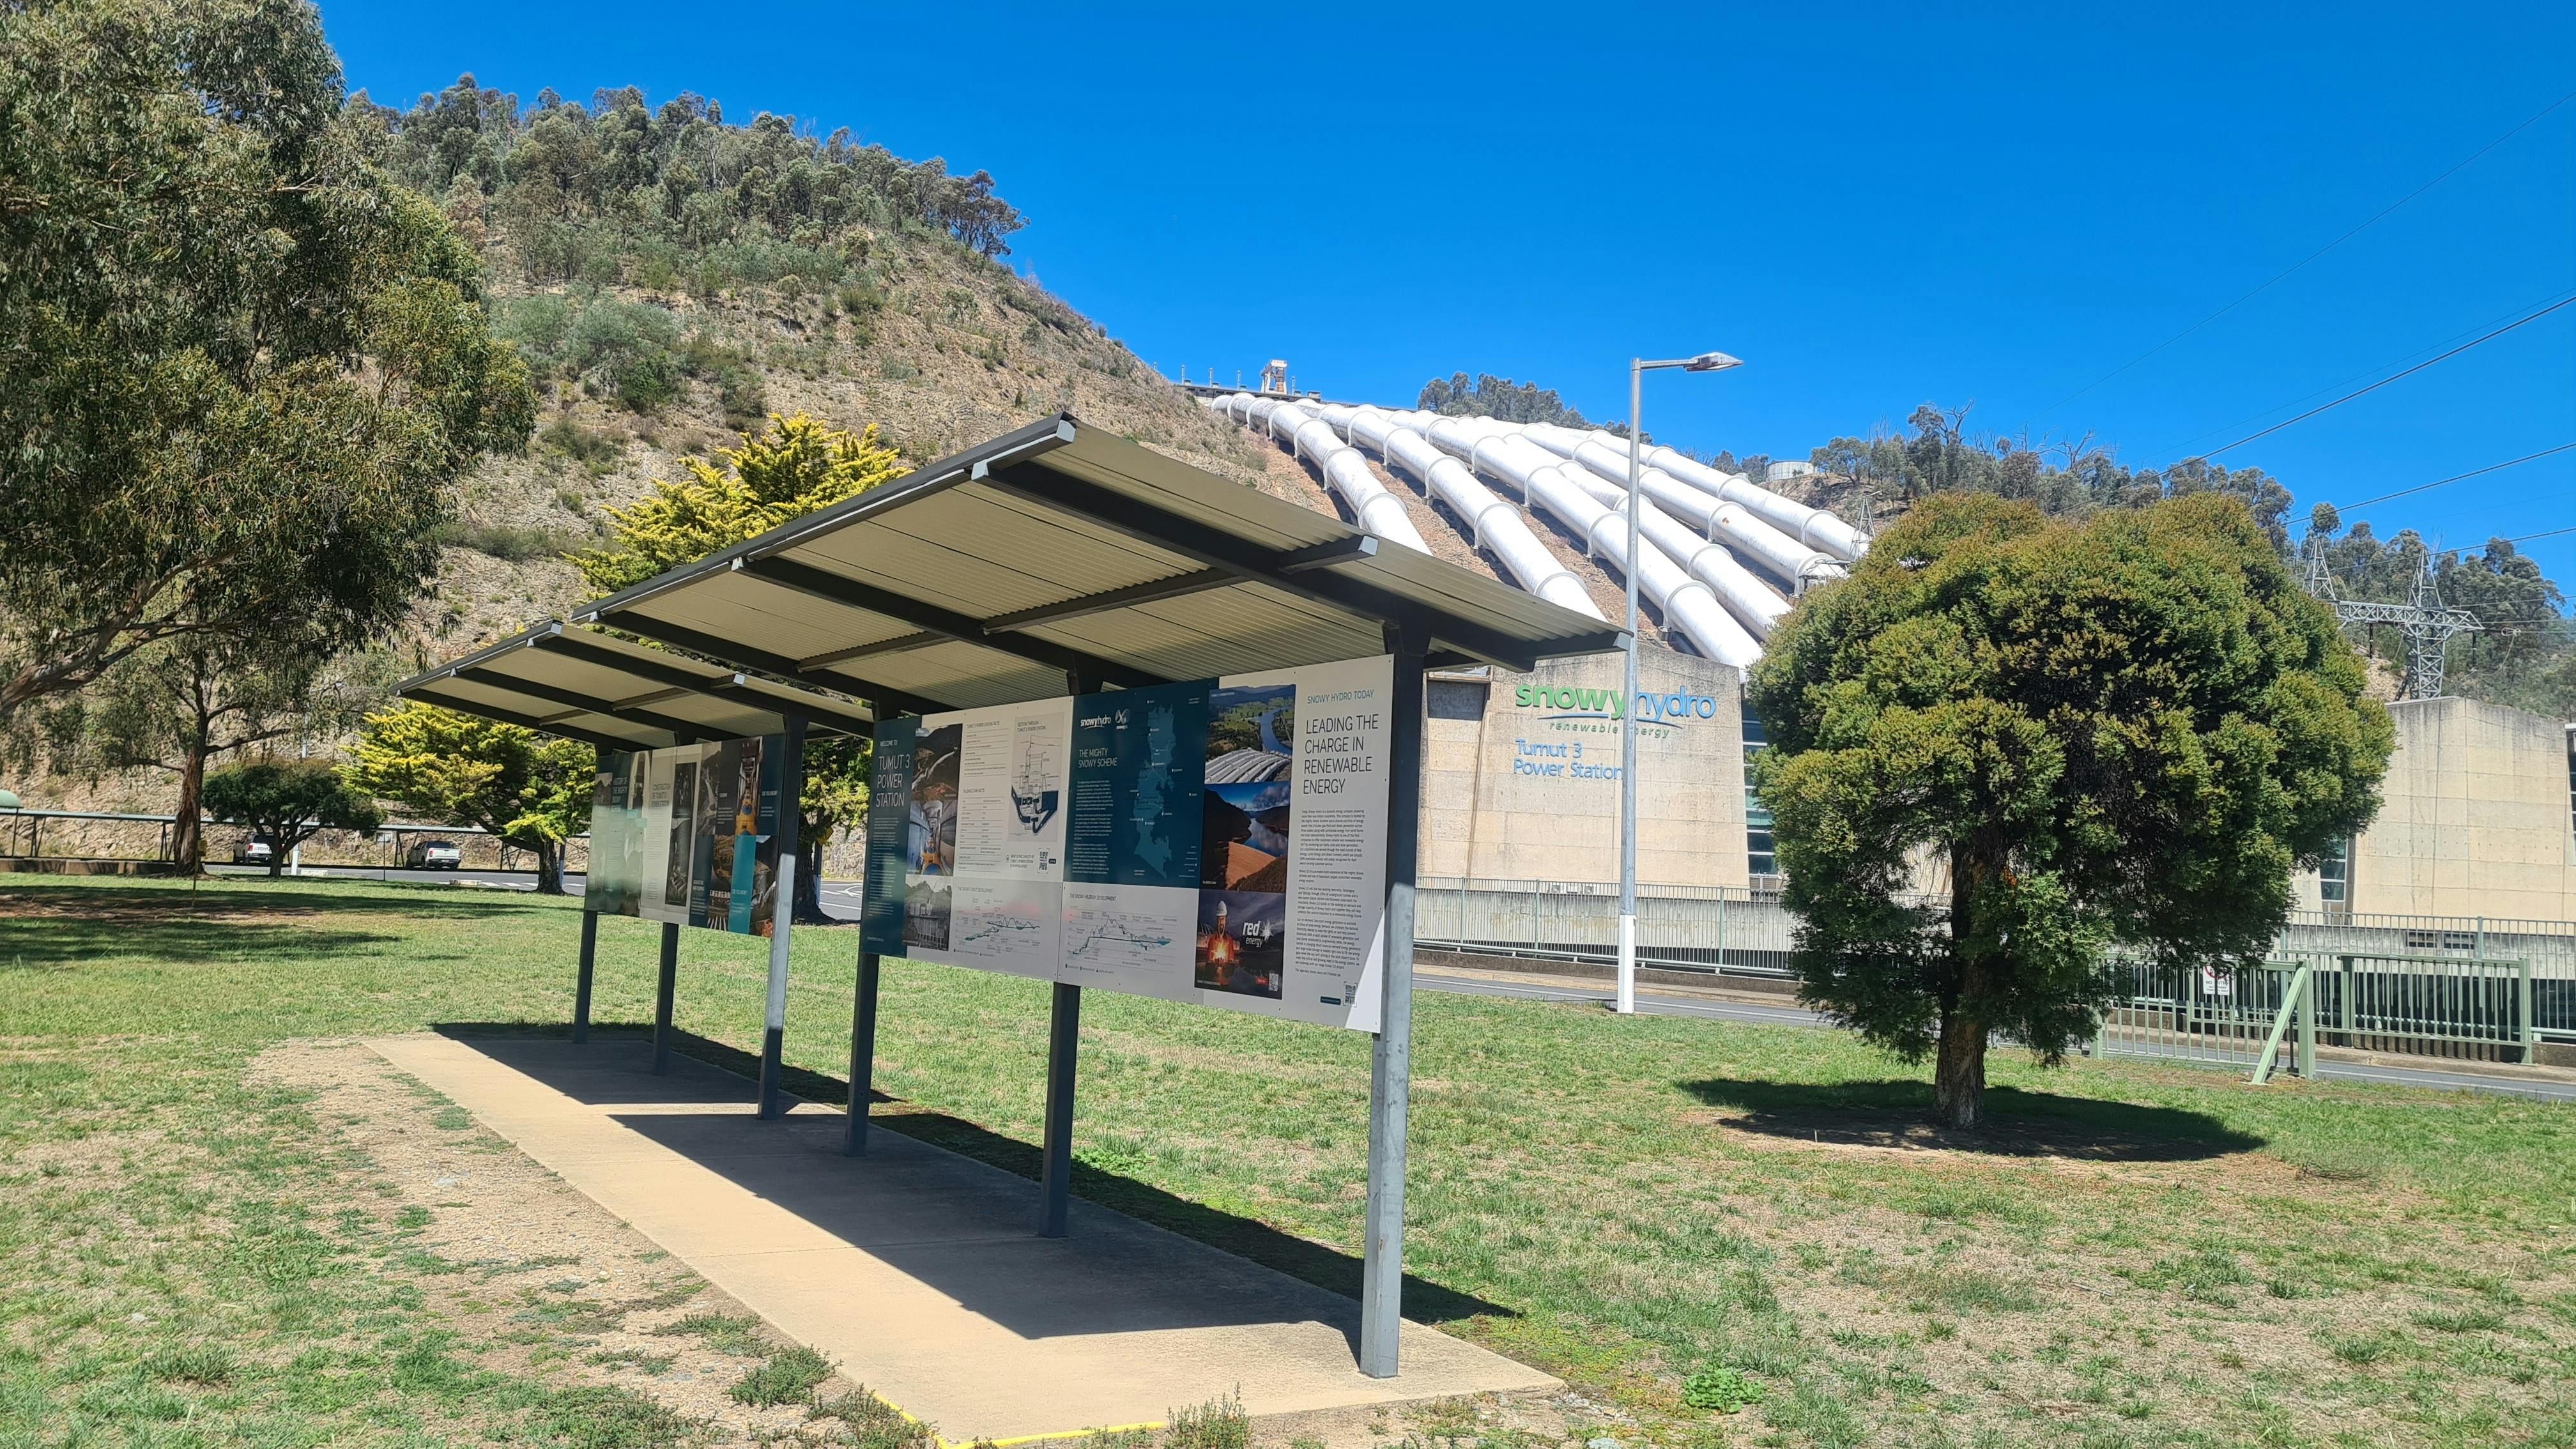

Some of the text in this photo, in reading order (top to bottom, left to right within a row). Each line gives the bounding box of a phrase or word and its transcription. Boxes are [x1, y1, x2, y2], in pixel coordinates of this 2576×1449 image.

[1307, 689, 1374, 704] SNOWY HYDRO TODAY
[1306, 714, 1379, 734] LEADING THE
[1549, 721, 1670, 739] renewable ergy
[1079, 747, 1108, 758] THE MIGHTY
[1305, 736, 1364, 754] CHARGE IN
[1515, 738, 1583, 758] Tumut 3
[879, 754, 910, 770] TUMUT 3
[1078, 757, 1117, 768] SNOWY SCHEME
[1304, 756, 1372, 774] RENEWABLE
[1514, 758, 1623, 779] Power Station
[877, 773, 903, 788] POWER
[1303, 778, 1346, 794] ENERGY
[876, 792, 905, 808] STATION
[1243, 921, 1261, 937] red
[1246, 937, 1264, 948] energy
